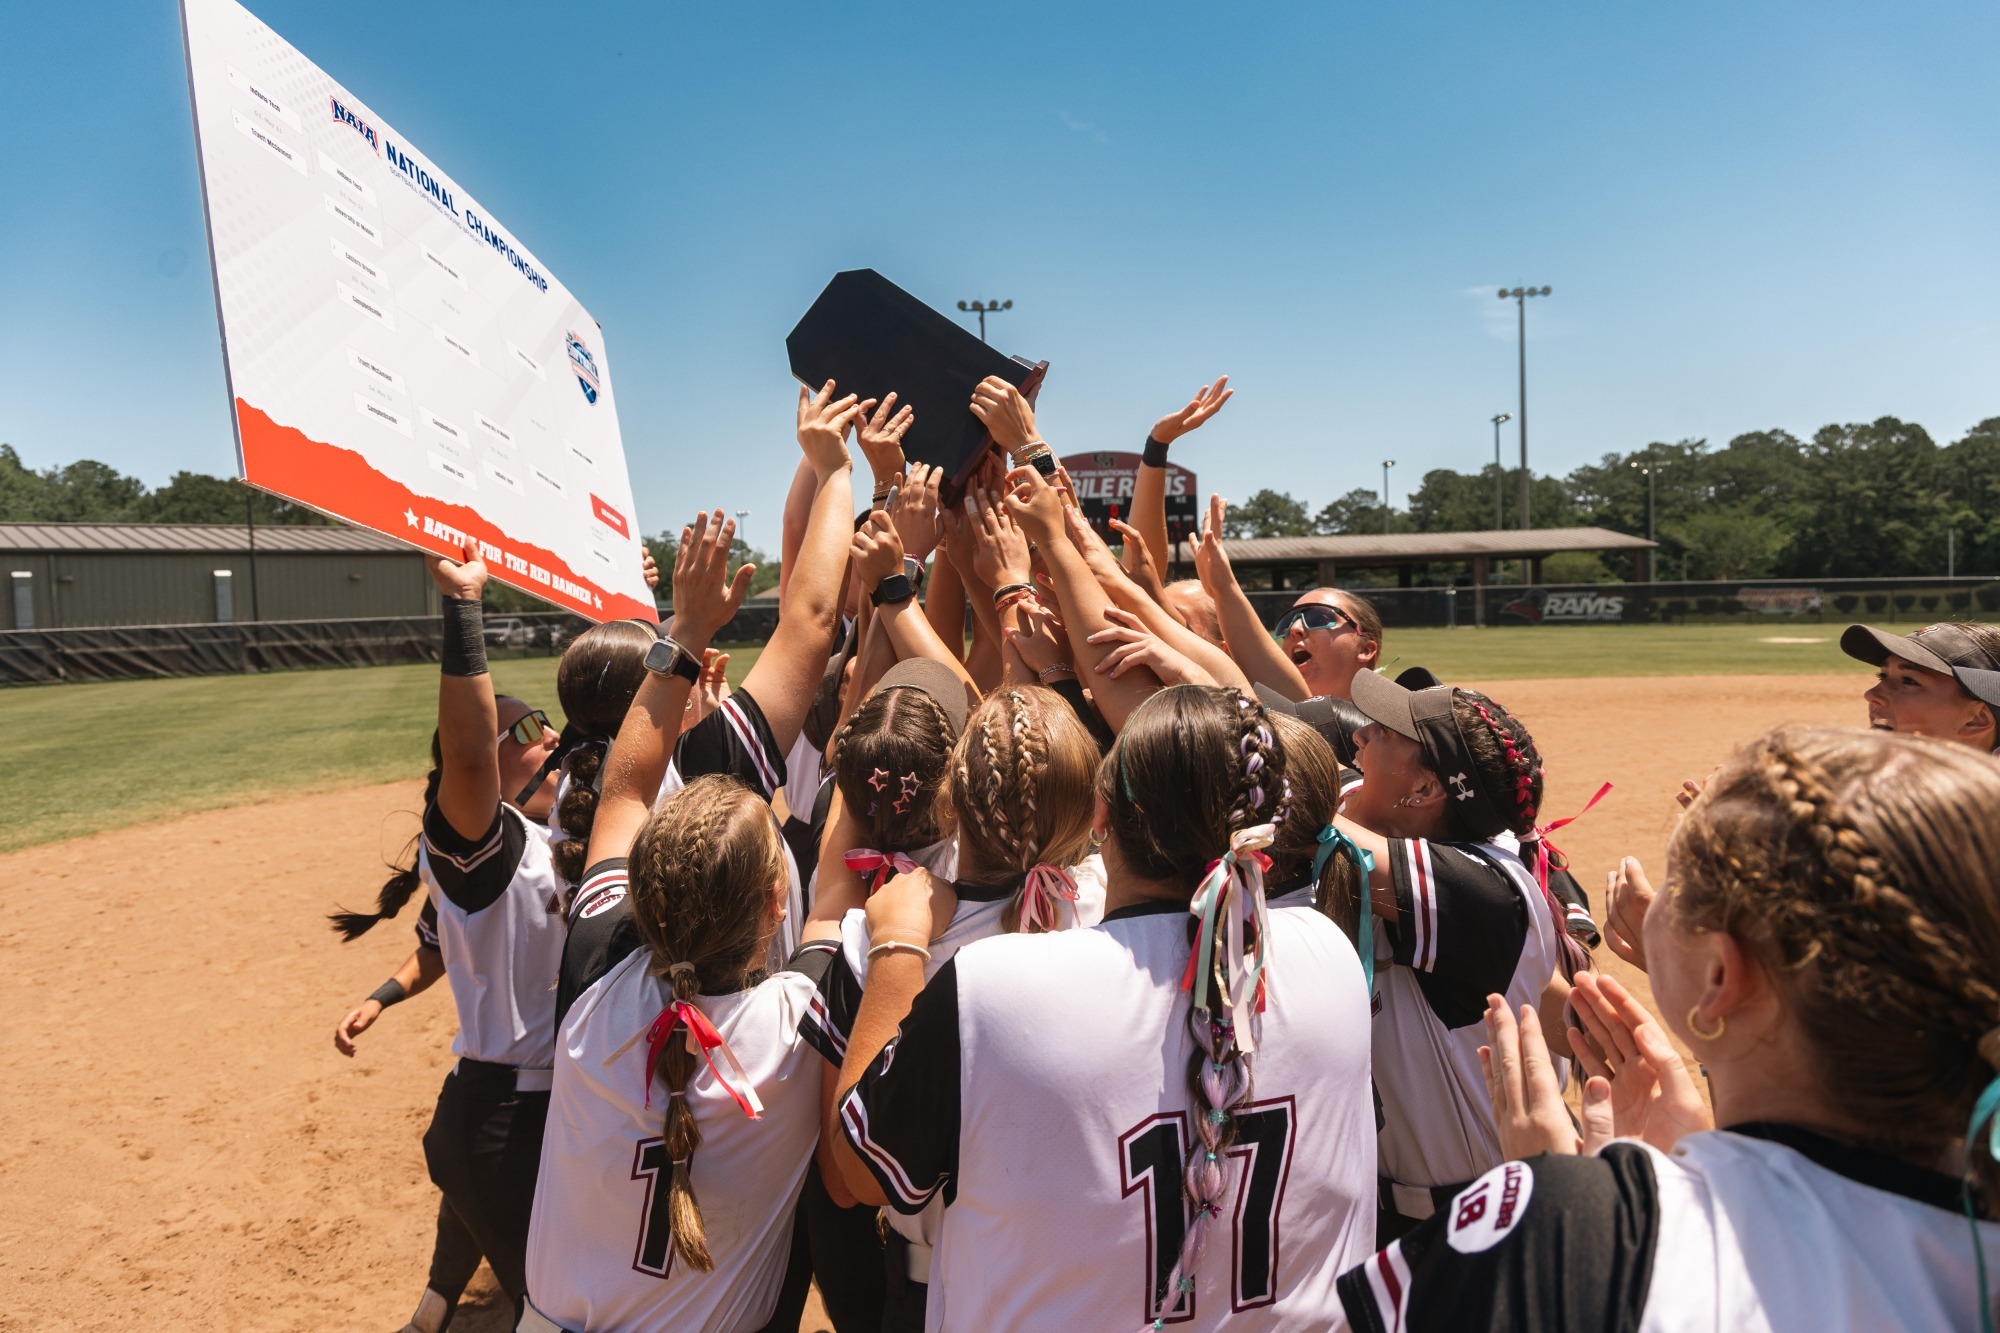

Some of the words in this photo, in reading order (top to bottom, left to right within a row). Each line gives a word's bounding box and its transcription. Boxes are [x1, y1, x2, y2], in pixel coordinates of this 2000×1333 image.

[250, 86, 268, 103] Indiana
[269, 100, 280, 112] Tech
[333, 99, 377, 151] NAIA
[389, 166, 418, 192] SOFTBALL
[386, 140, 459, 217] NATIONAL
[466, 209, 547, 294] CHAMPIONSHIP
[423, 516, 477, 549] BATTL
[479, 540, 502, 565] FOR
[504, 552, 528, 577] THE
[530, 563, 551, 586] RED
[552, 574, 592, 605] BANNER
[1543, 596, 1624, 615] RAMS
[1118, 1094, 1297, 1324] 17
